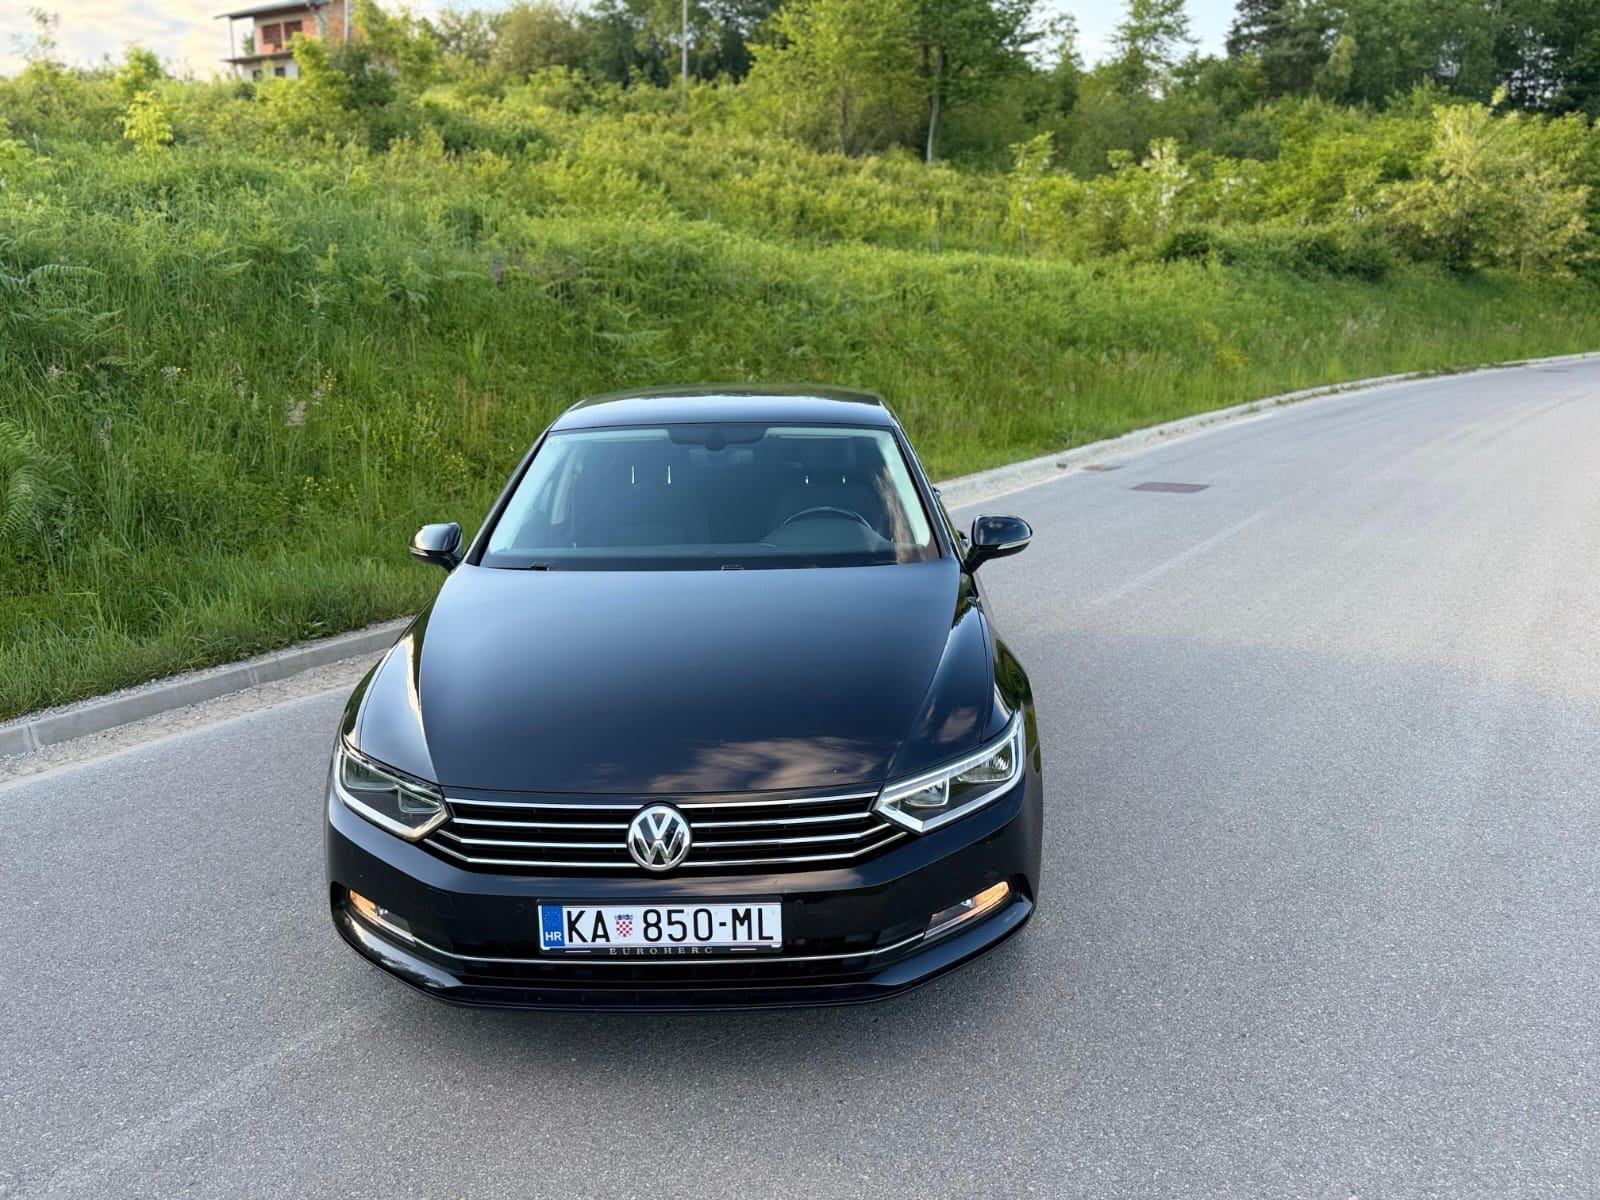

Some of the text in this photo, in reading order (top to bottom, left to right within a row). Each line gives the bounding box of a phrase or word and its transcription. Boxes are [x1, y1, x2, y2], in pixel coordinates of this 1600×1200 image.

[629, 807, 689, 869] VW
[545, 931, 562, 942] HR
[566, 908, 774, 943] KA 850-ML
[609, 946, 713, 955] EUROHERC
